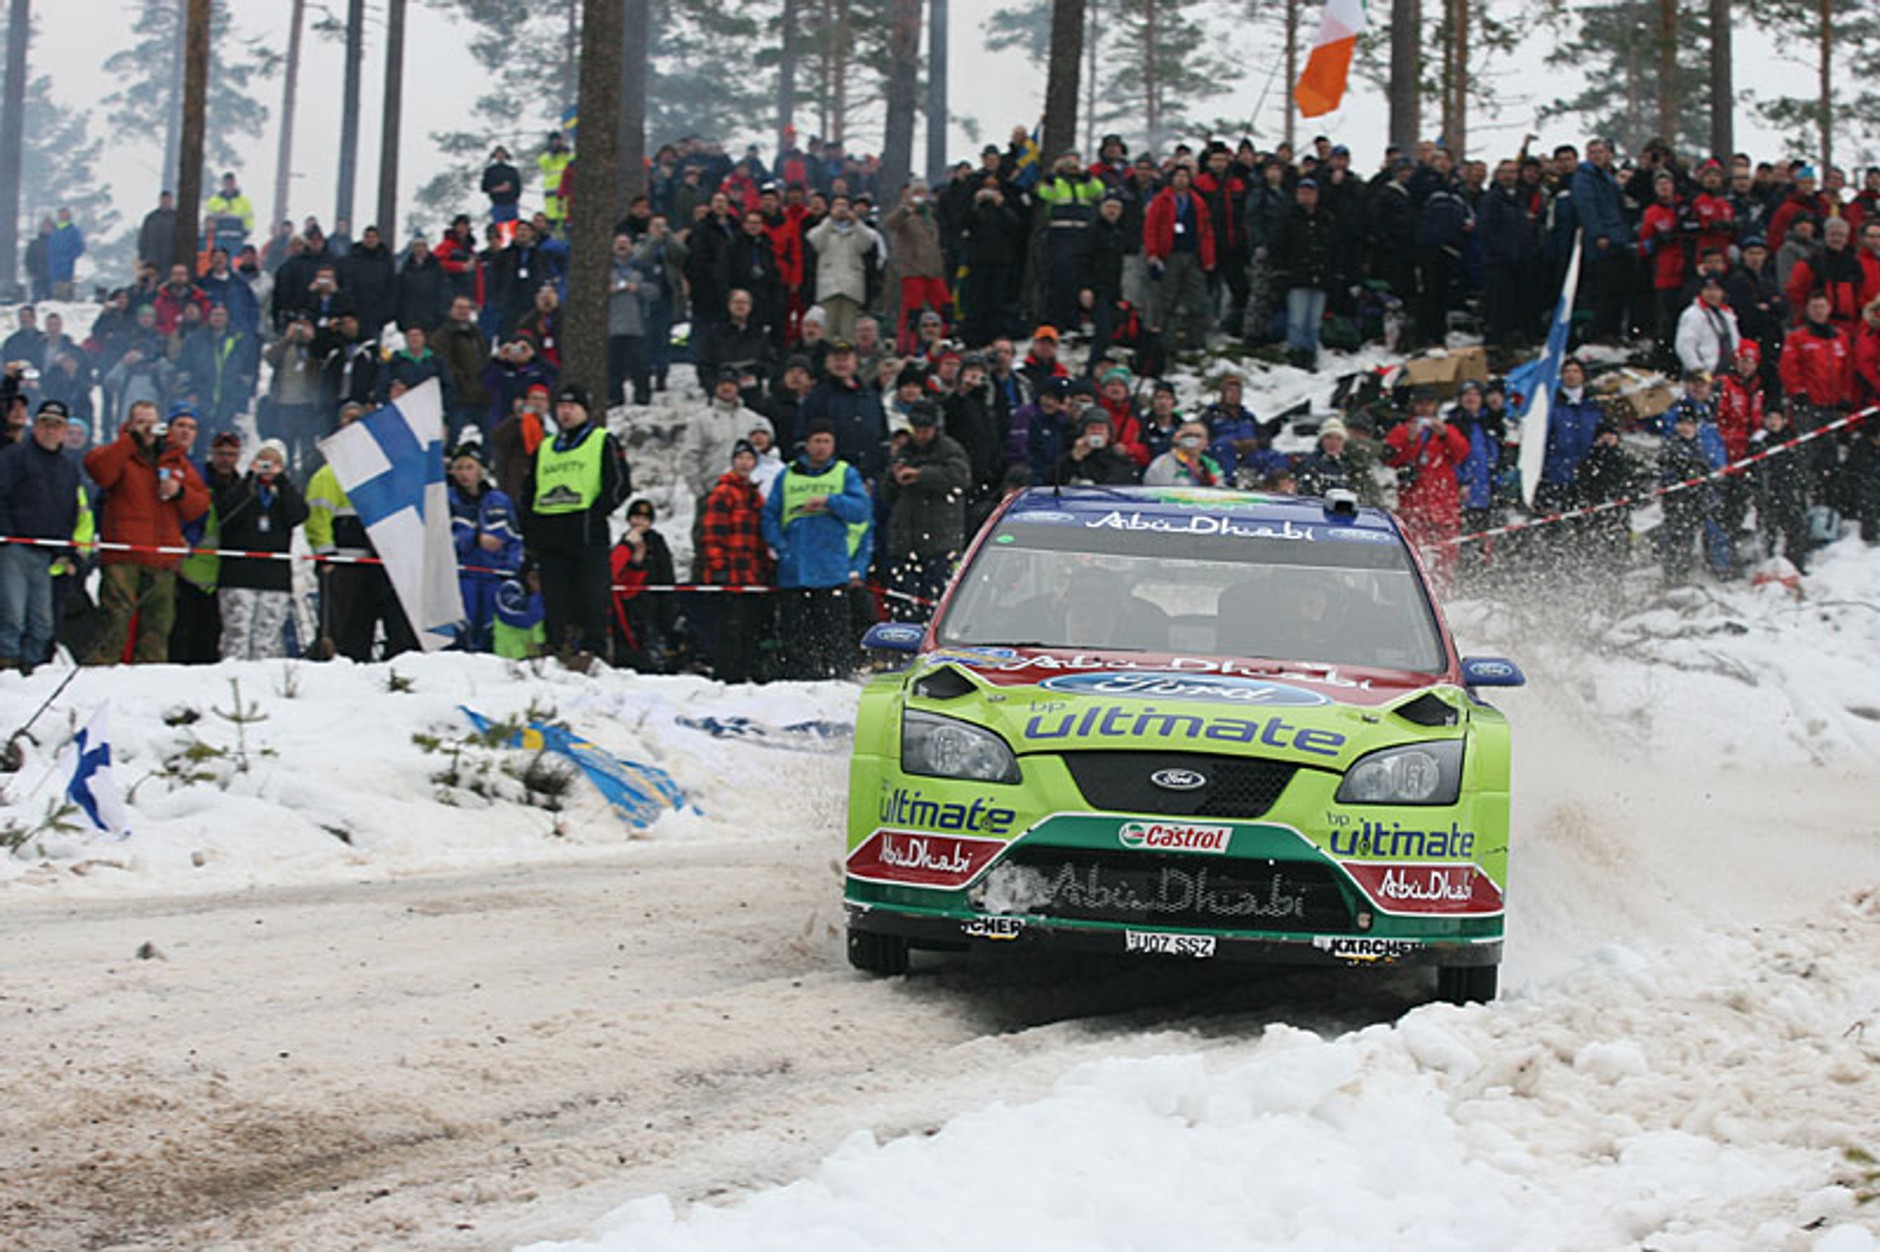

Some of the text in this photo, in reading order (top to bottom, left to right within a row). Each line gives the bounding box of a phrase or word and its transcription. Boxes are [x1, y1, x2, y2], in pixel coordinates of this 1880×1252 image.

[543, 460, 586, 475] SAFETY
[788, 483, 837, 495] SAFETY
[1085, 511, 1172, 532] Abu
[1186, 516, 1316, 541] Dhabi
[1093, 675, 1278, 700] Ford
[1030, 700, 1067, 713] bp
[1024, 706, 1347, 756] ultimate
[880, 789, 1016, 833] ultimate
[1327, 810, 1350, 827] bp
[1146, 825, 1224, 849] Castrol
[1330, 821, 1475, 857] ultimate
[1048, 862, 1308, 918] Abu Dhabi
[1376, 868, 1424, 899] Abu
